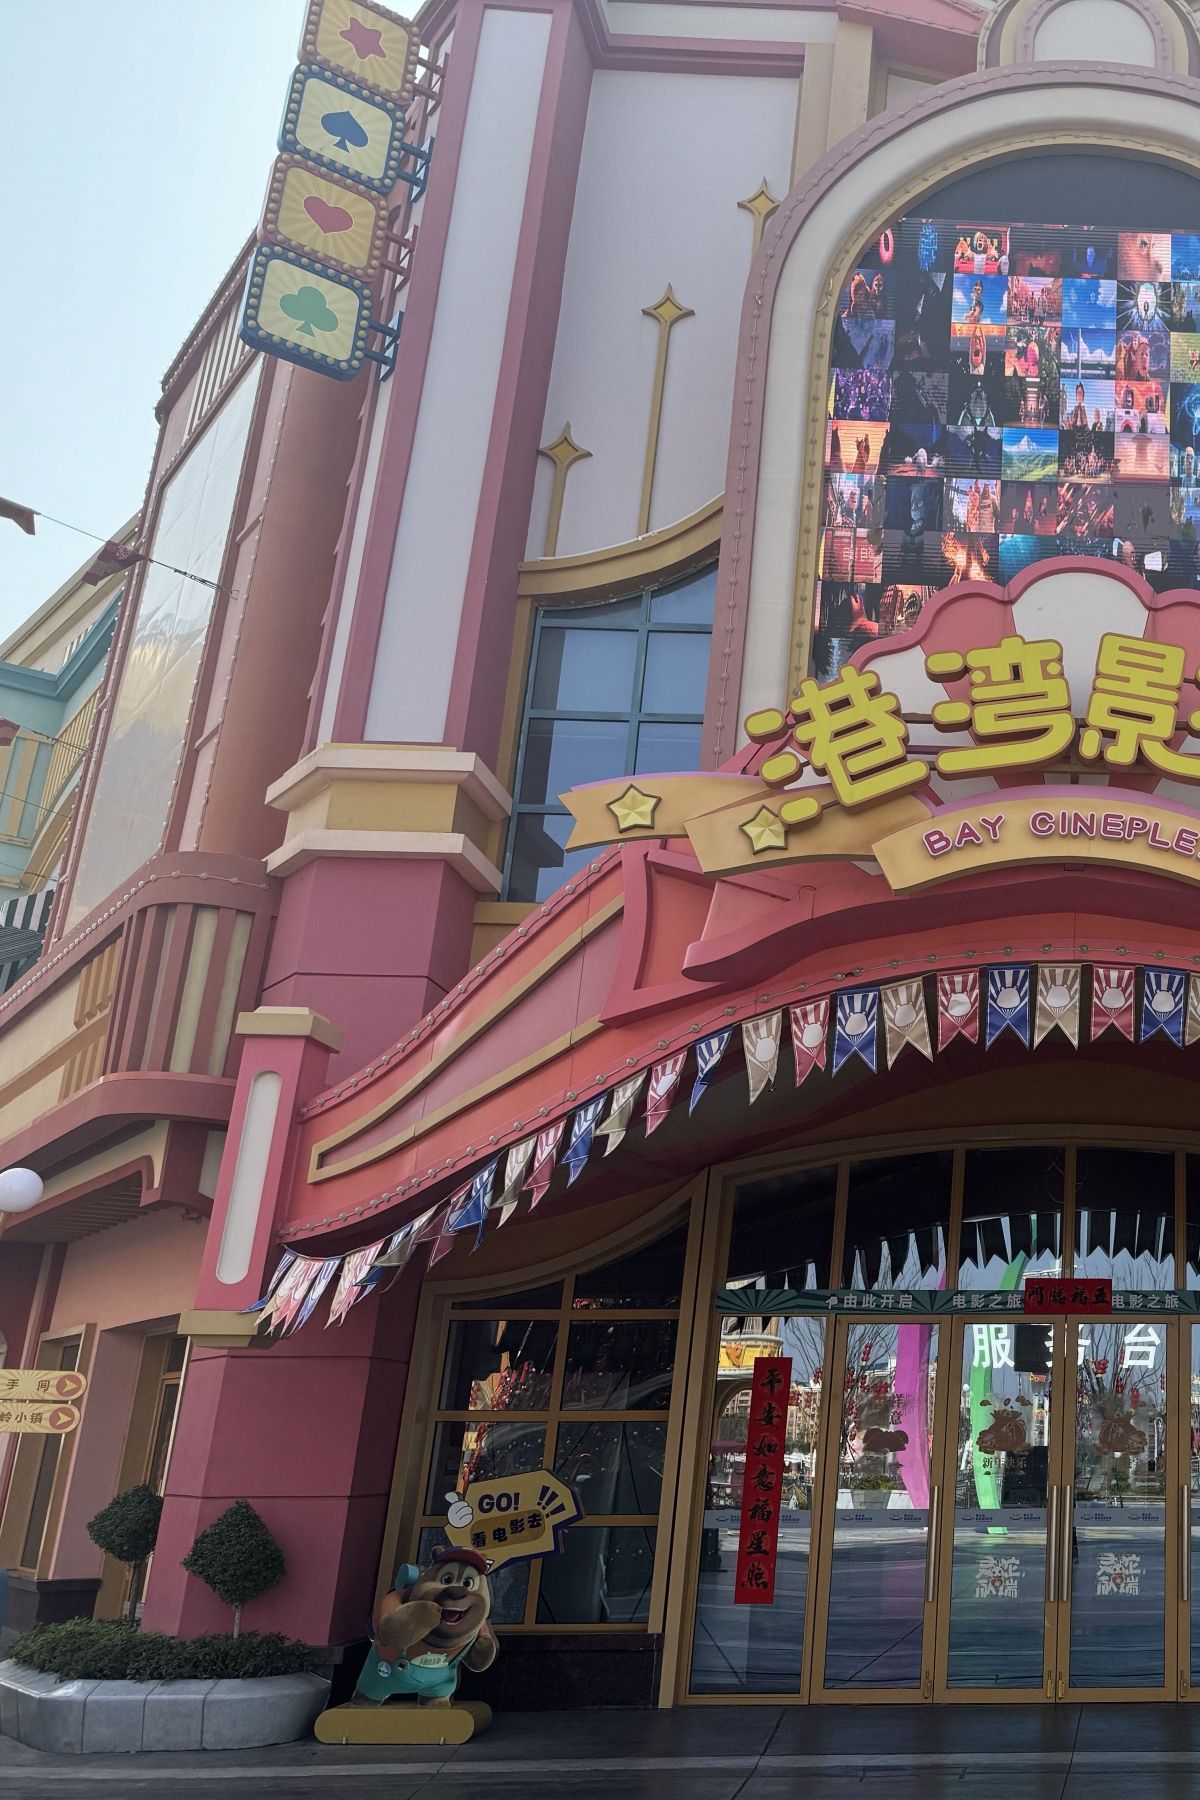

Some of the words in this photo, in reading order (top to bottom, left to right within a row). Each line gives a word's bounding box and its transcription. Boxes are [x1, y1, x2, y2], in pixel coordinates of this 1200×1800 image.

[922, 814, 1005, 857] BAY
[843, 1294, 914, 1309] 由此开启
[952, 1294, 1022, 1309] 电影之旅
[1111, 1295, 1179, 1309] 电影之旅
[477, 1492, 520, 1513] GO!
[471, 1512, 543, 1548] 看电影去
